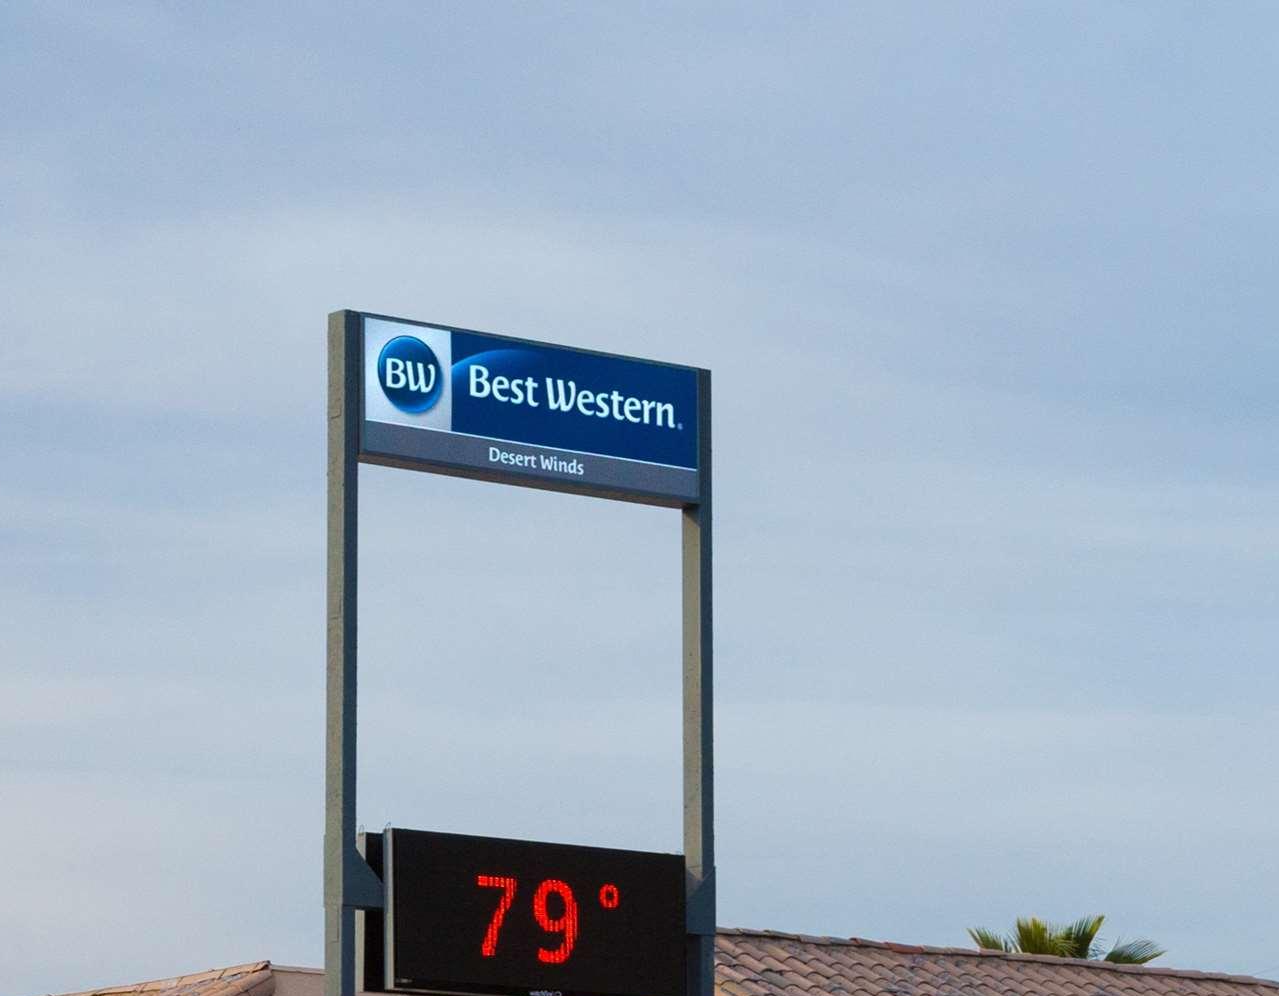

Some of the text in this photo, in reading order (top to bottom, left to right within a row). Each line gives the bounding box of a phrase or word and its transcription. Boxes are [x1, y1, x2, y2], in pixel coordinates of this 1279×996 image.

[384, 356, 437, 394] BW
[468, 364, 676, 430] Best Western
[488, 446, 585, 477] Desert Winds
